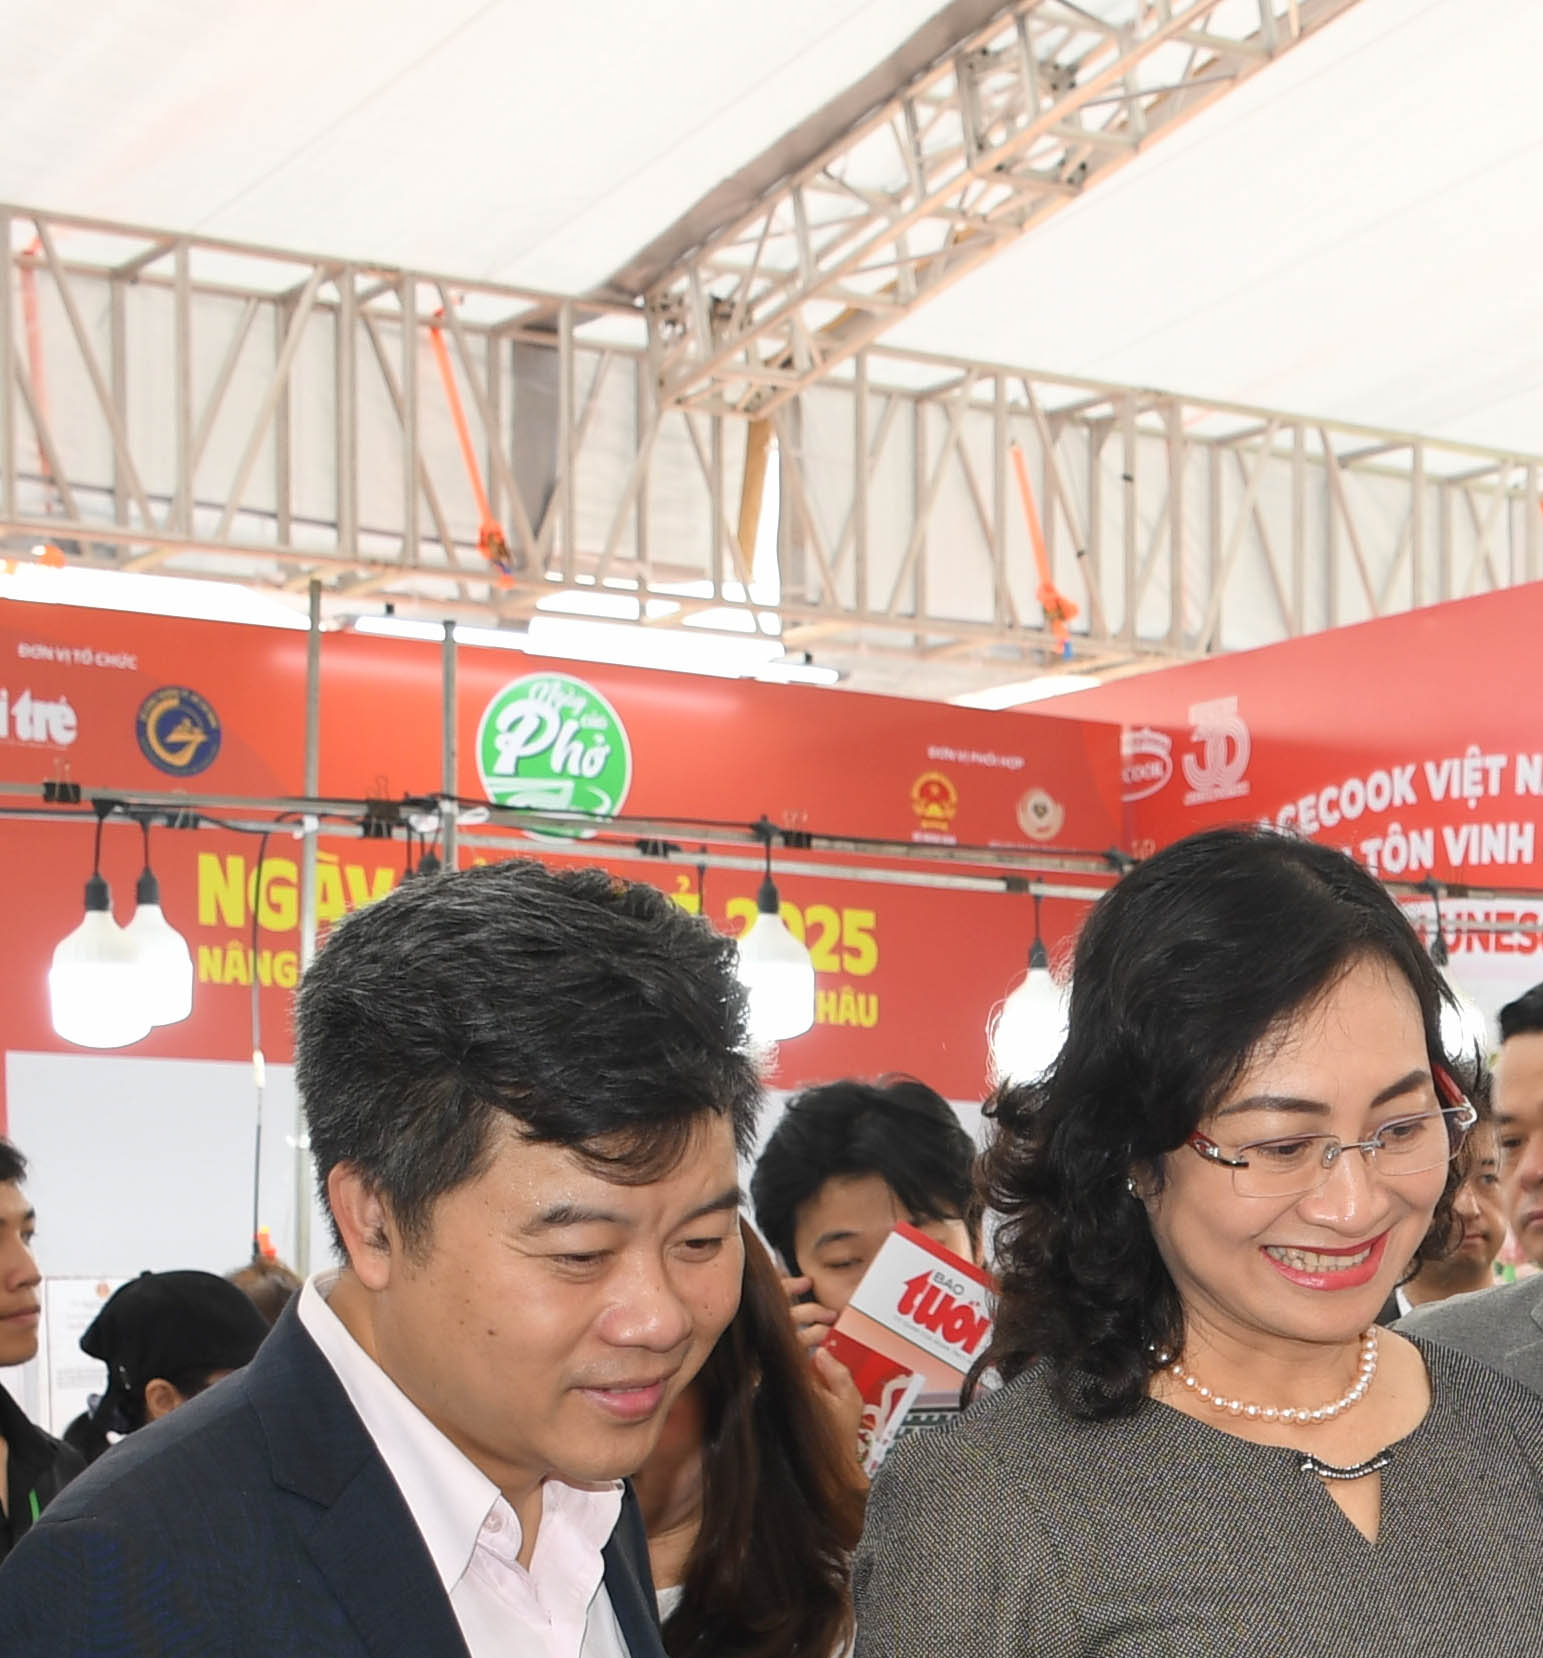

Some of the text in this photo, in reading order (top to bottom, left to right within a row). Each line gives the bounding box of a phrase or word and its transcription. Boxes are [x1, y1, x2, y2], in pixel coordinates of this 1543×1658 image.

[493, 699, 611, 778] Phở
[1424, 744, 1507, 810] VIỆT
[1360, 821, 1434, 877] TÔN
[1443, 822, 1535, 868] VINH
[198, 940, 298, 989] NÂNG
